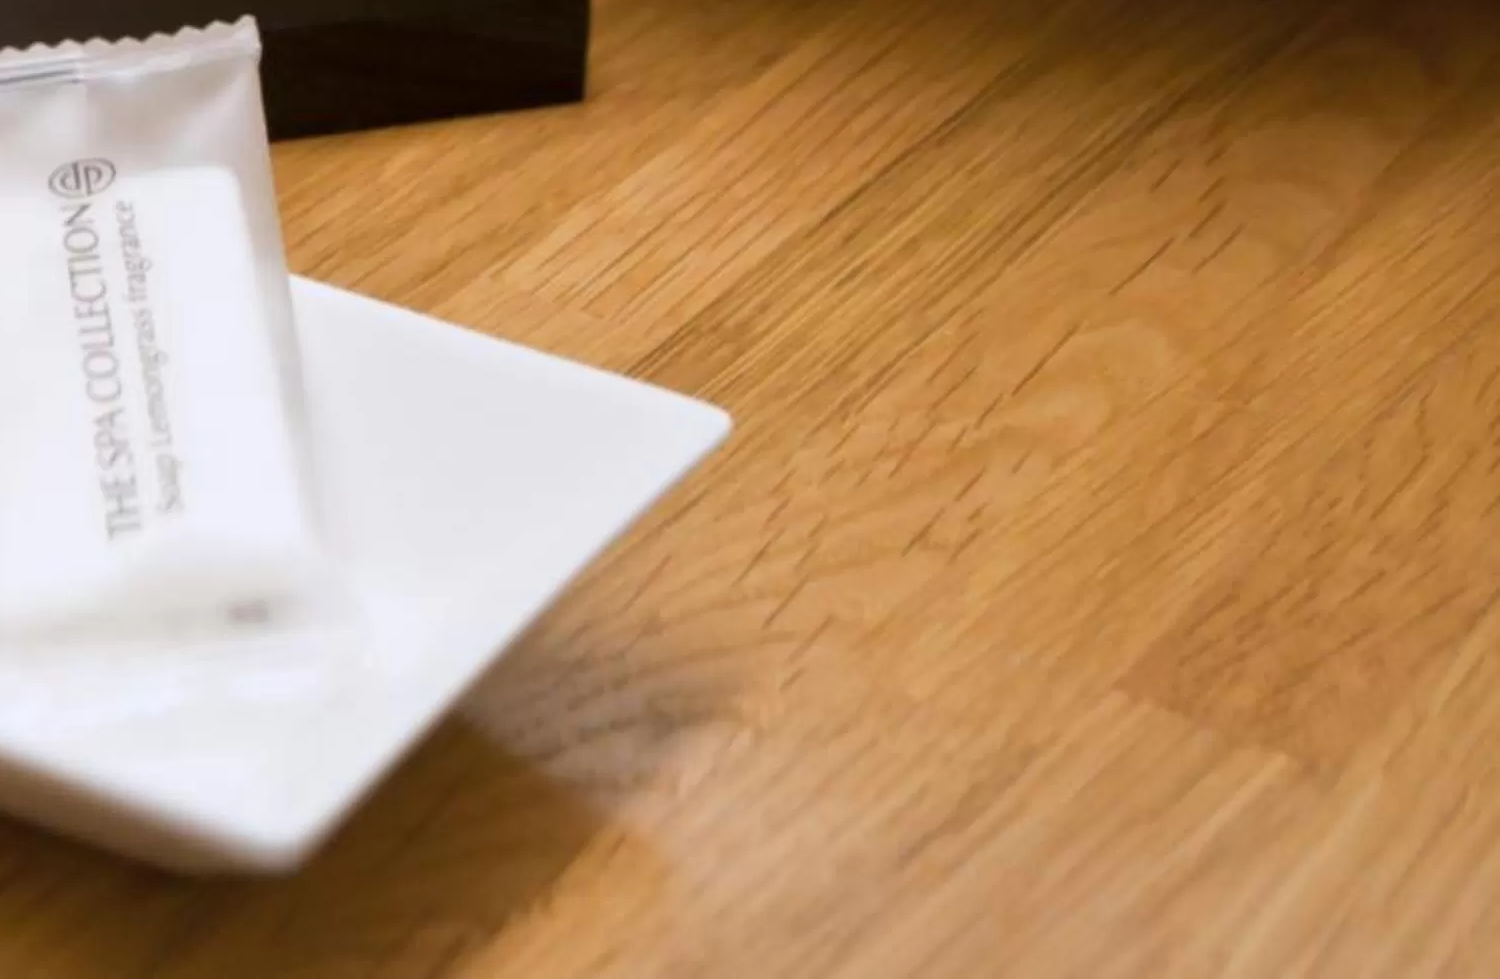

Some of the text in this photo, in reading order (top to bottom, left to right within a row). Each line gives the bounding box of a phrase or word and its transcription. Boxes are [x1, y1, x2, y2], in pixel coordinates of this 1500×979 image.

[59, 202, 141, 541] THE SPA COLLECTION
[114, 199, 186, 514] Soap Lemongrass fragrance
